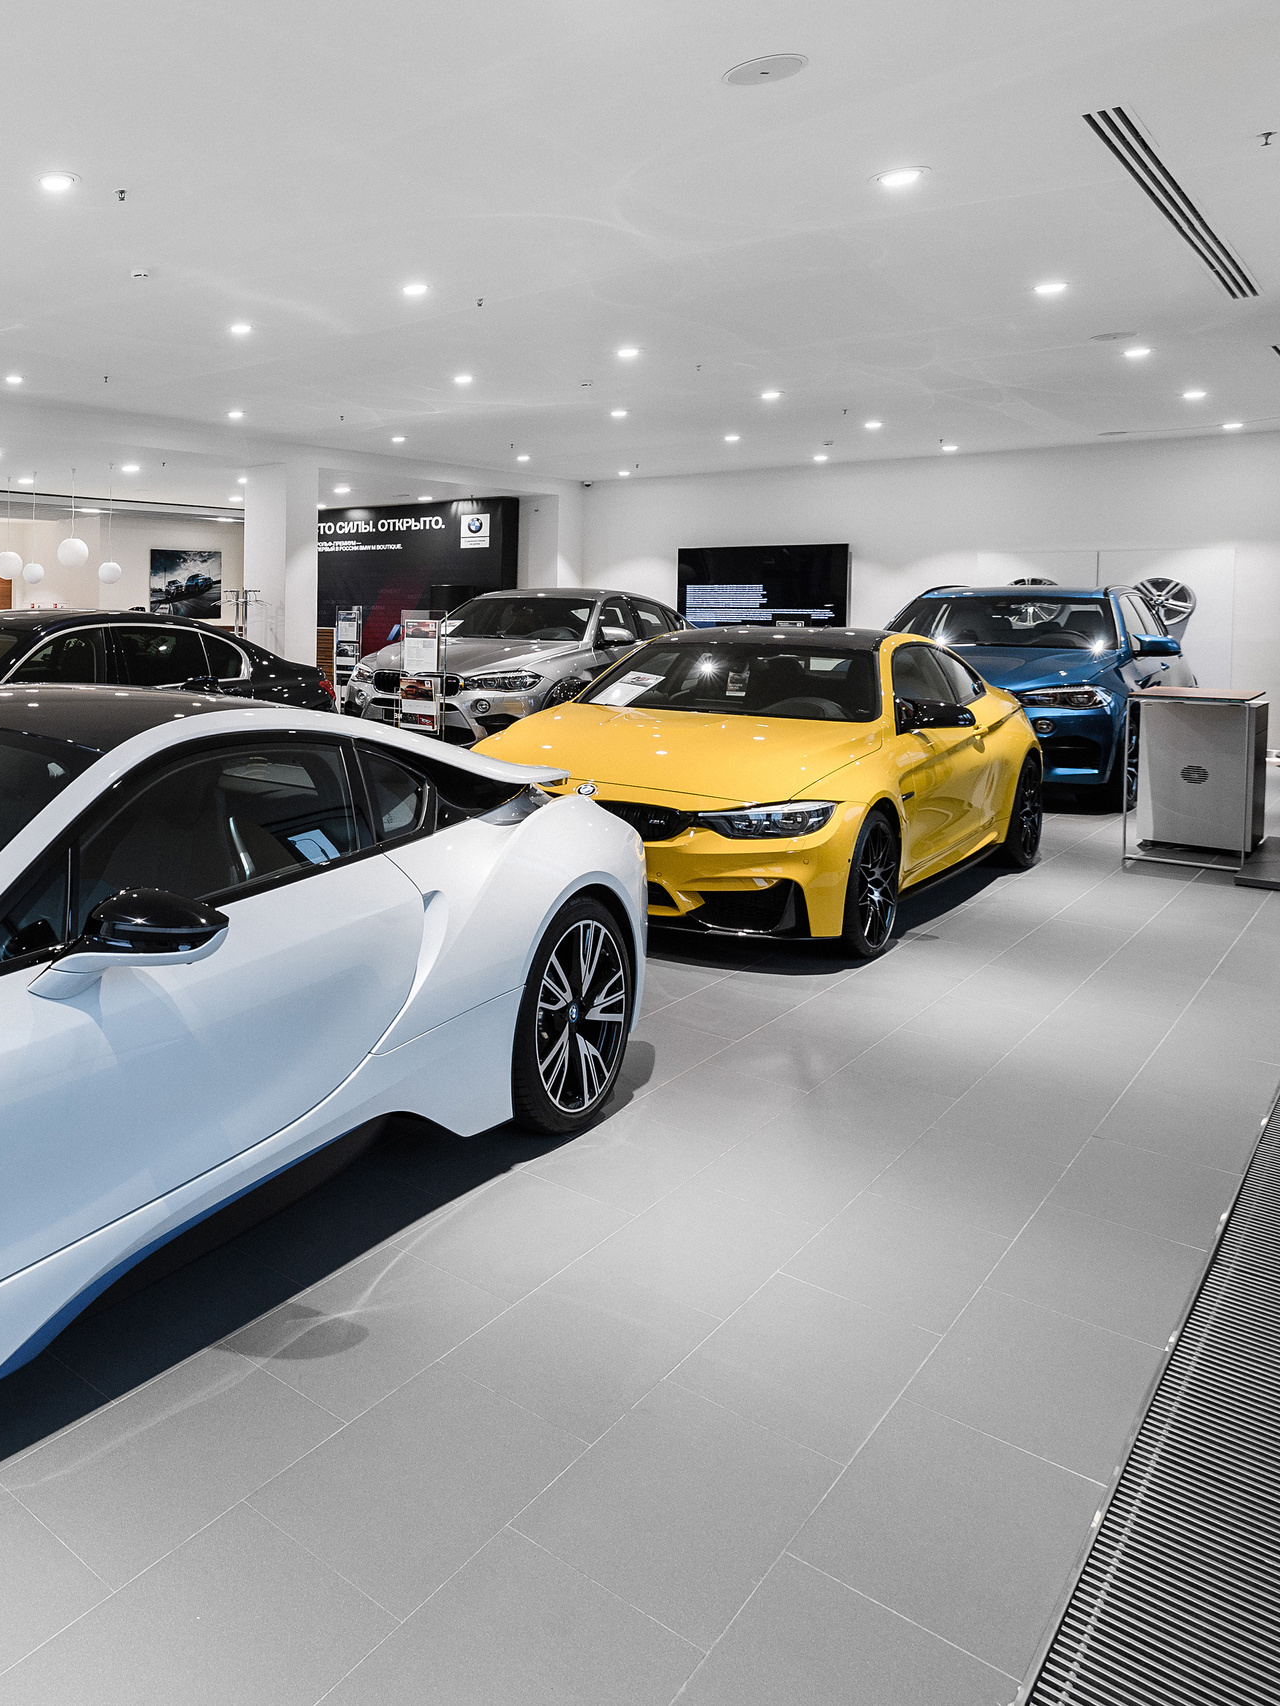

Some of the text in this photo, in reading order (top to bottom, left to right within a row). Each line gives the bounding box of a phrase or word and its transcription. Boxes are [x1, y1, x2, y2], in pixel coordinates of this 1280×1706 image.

[317, 516, 446, 535] ТО СИЛЫ. ОТКРЫТО.
